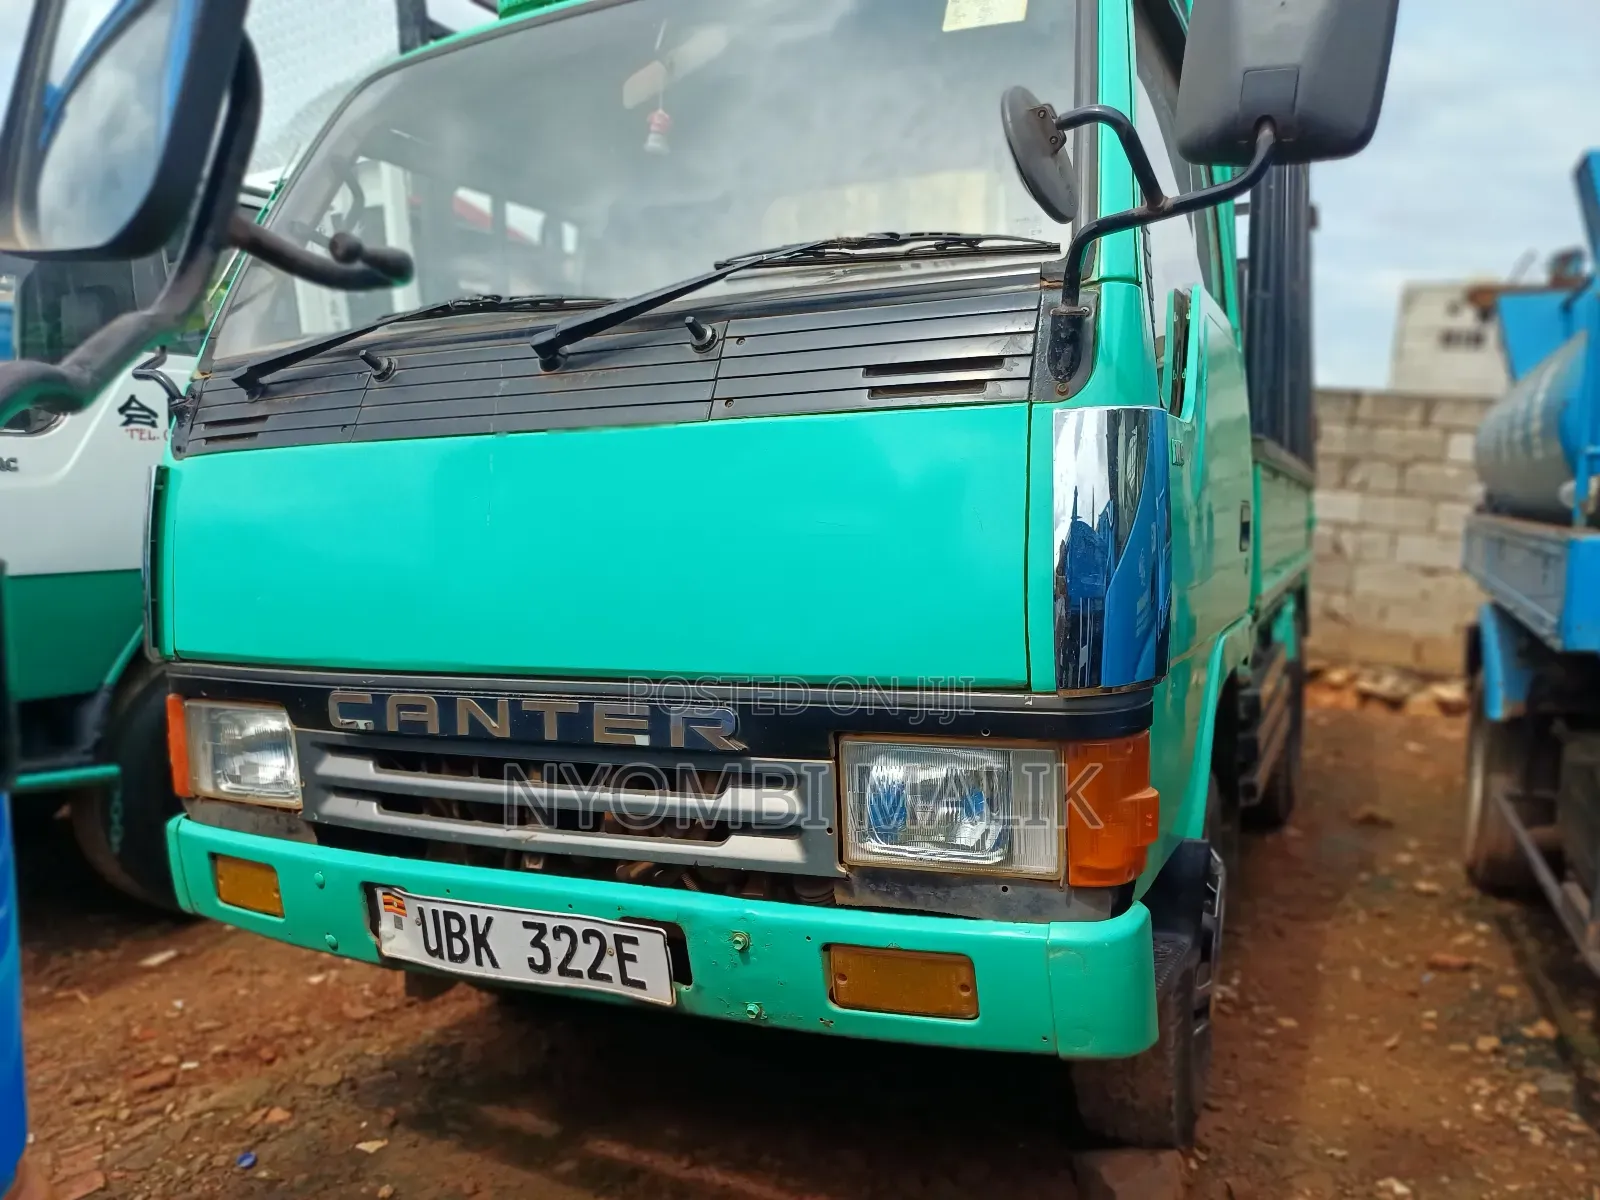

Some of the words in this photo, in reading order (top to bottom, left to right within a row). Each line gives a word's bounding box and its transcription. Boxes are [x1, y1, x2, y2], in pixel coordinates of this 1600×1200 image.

[328, 689, 748, 751] CANTER
[417, 906, 501, 969] UBK
[522, 920, 647, 990] 322E
